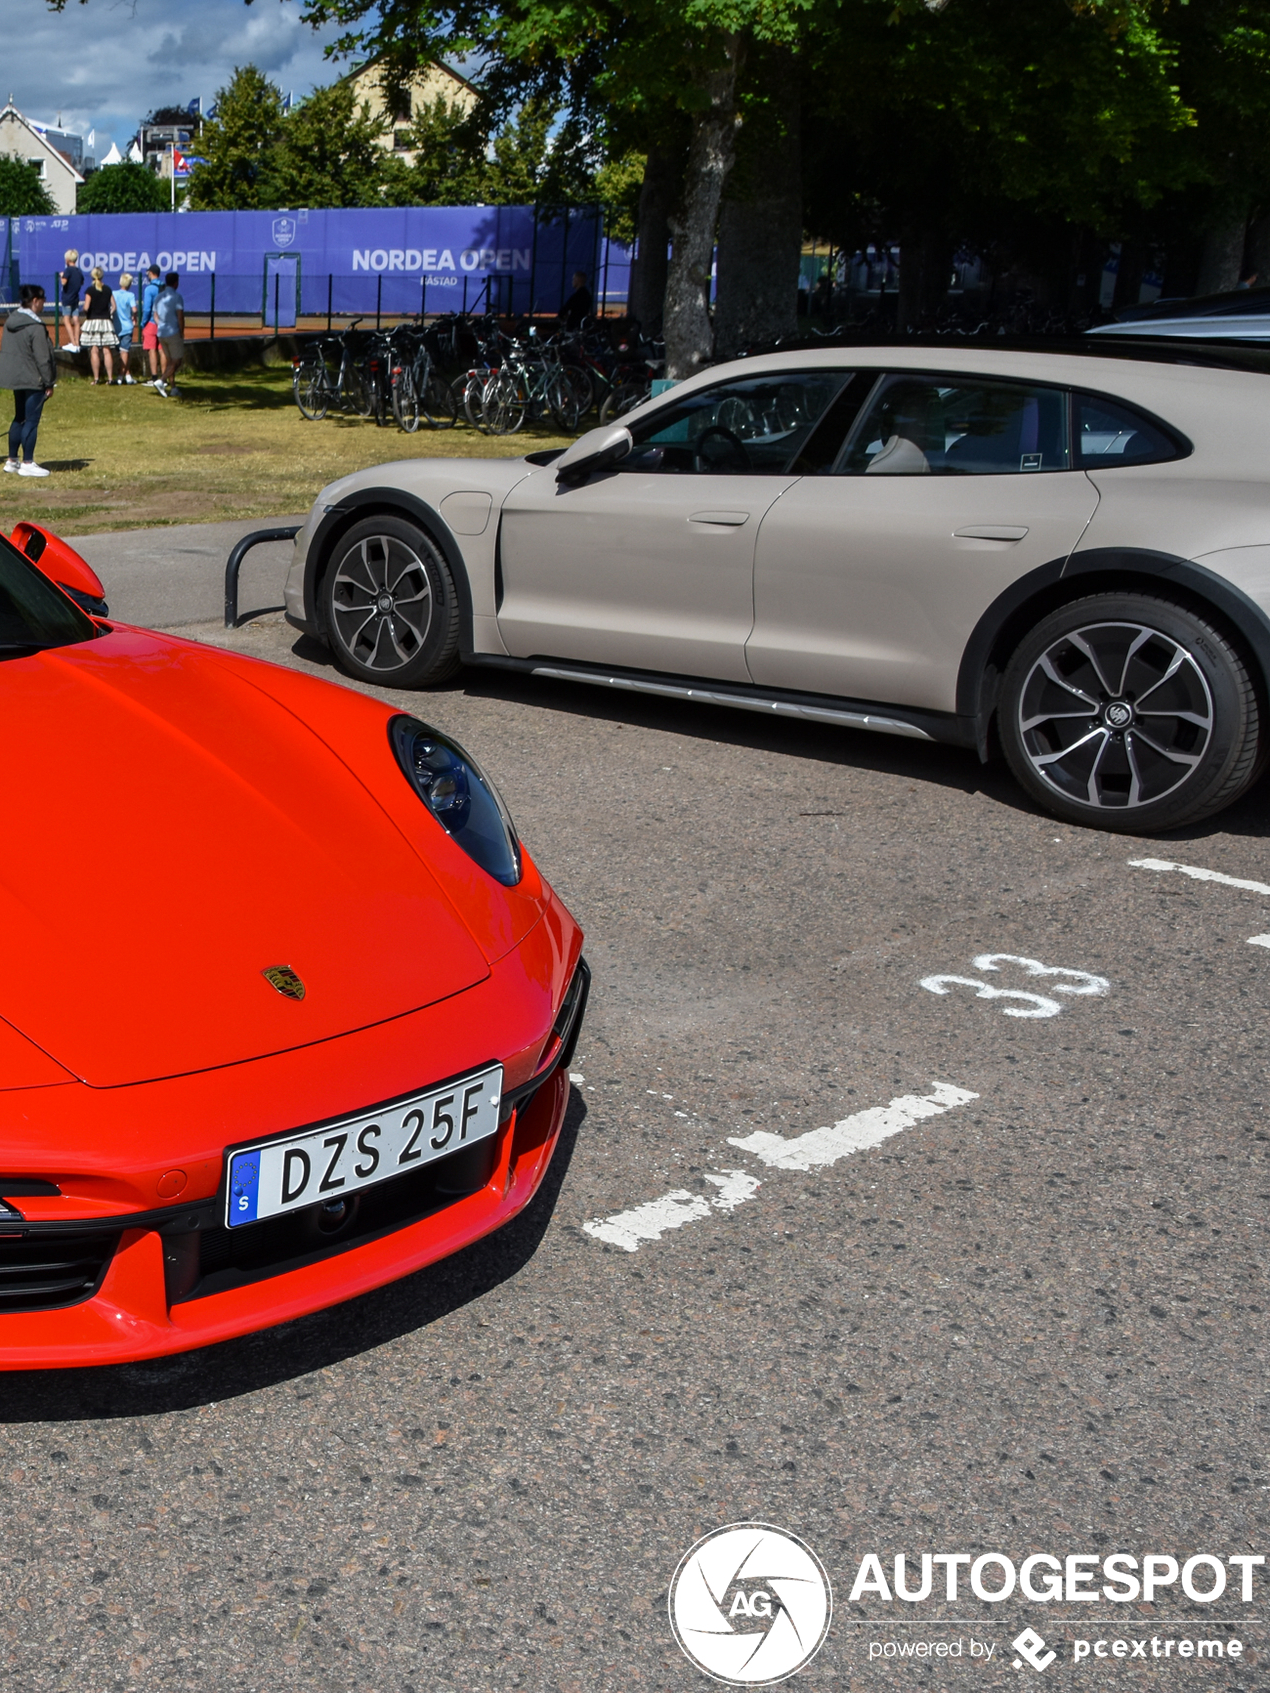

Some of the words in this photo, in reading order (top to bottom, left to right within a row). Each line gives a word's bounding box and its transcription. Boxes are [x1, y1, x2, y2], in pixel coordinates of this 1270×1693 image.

[65, 251, 151, 272] ORDEA
[156, 251, 216, 271] OPEN
[352, 249, 456, 271] NORDEA
[459, 249, 530, 271] OPEN
[281, 1124, 381, 1205] DZS
[398, 1081, 484, 1165] 25F
[238, 1195, 249, 1211] S
